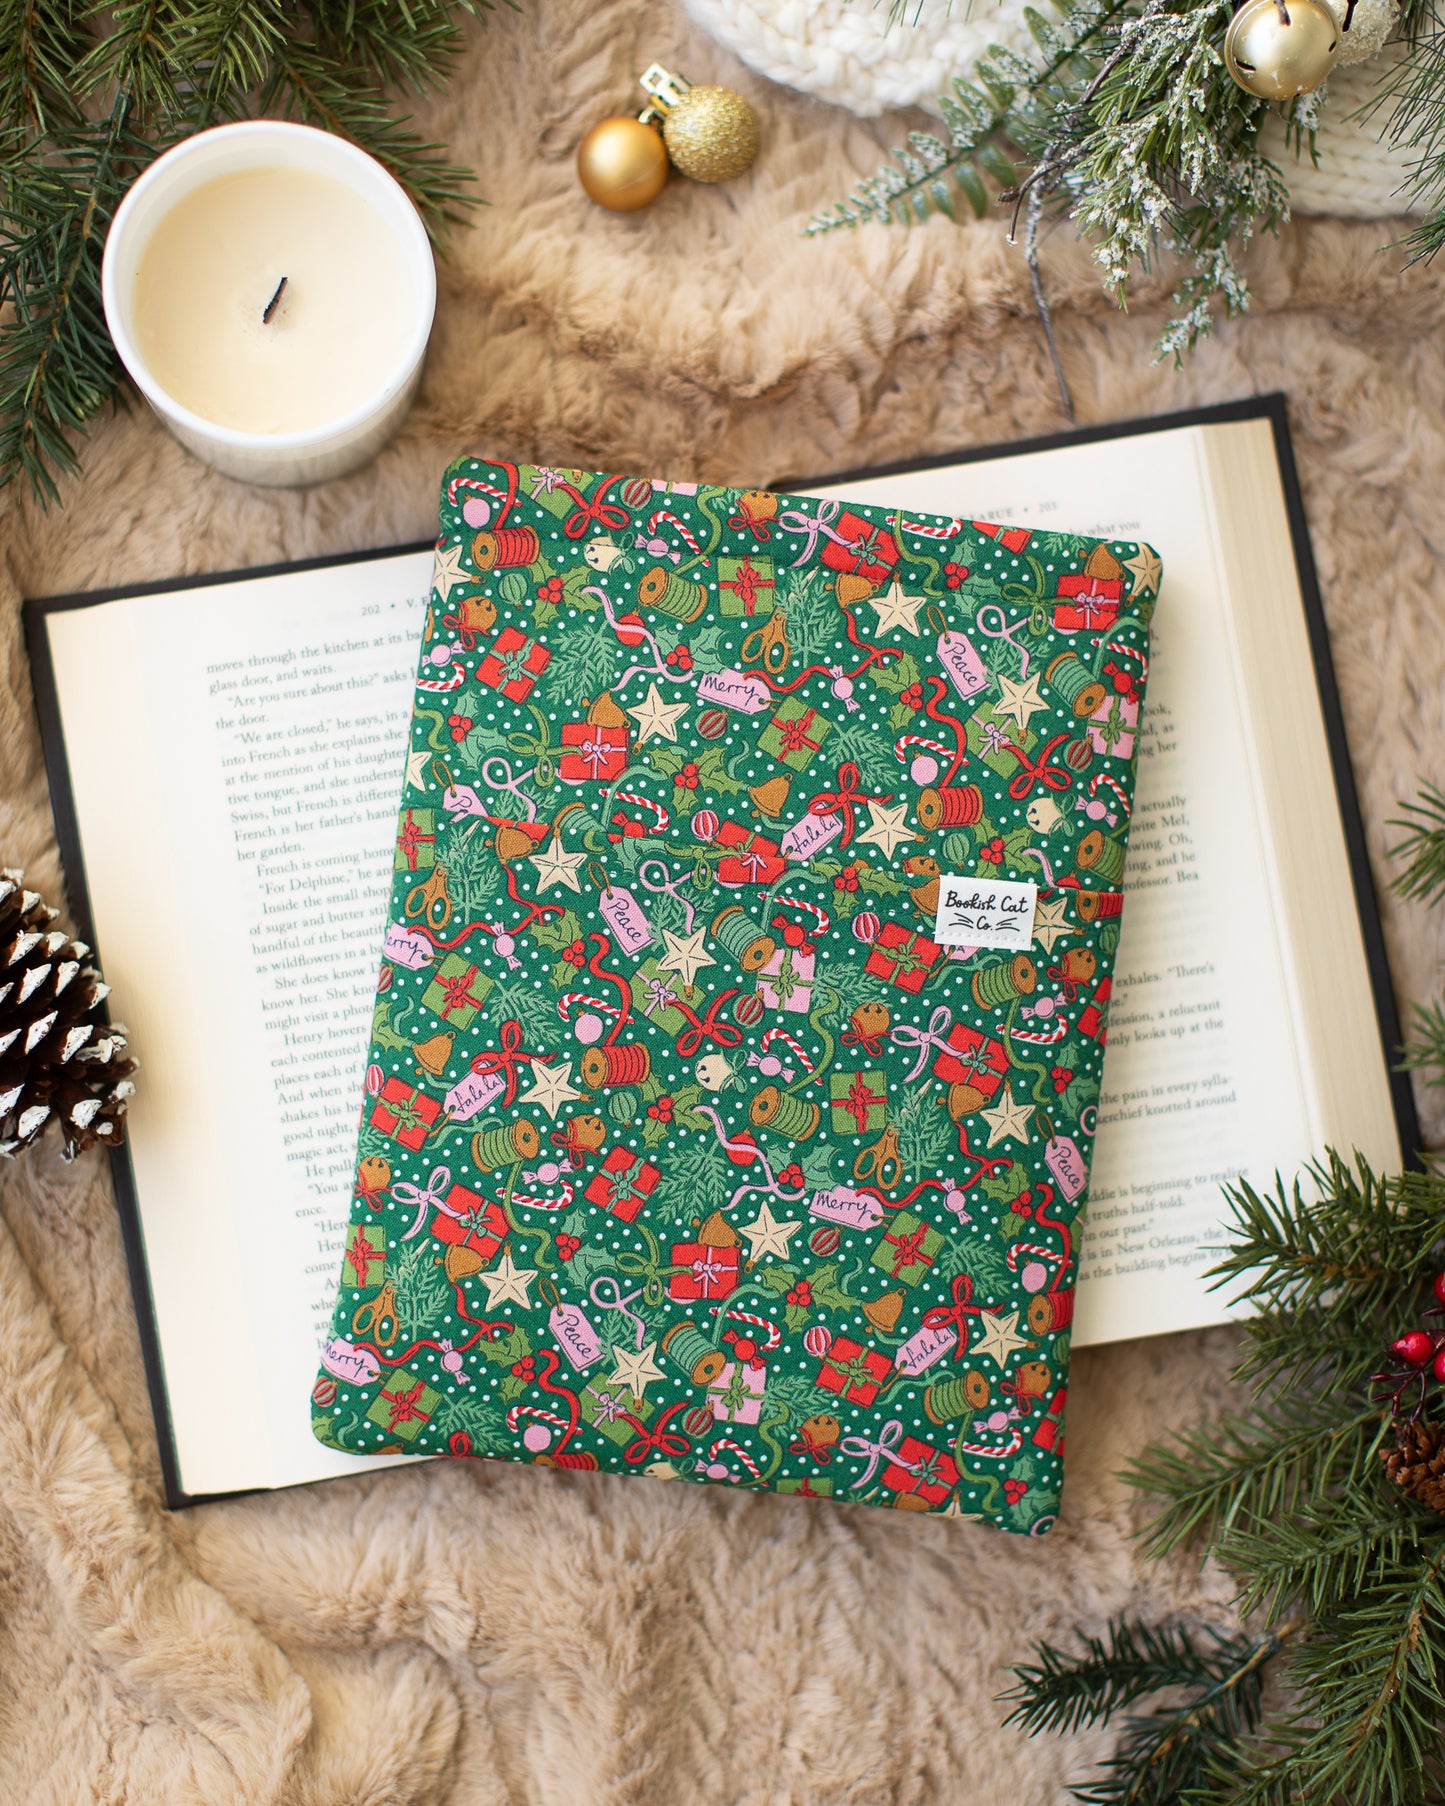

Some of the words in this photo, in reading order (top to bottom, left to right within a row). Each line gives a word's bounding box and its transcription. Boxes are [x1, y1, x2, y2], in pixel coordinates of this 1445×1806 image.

[360, 603, 381, 616] 202
[206, 660, 245, 674] moves
[247, 648, 297, 667] through
[300, 645, 320, 659] the
[323, 639, 369, 655] kitchen
[387, 633, 403, 644] its
[945, 642, 978, 687] Peace
[209, 679, 239, 696] glass
[275, 666, 299, 683] and
[258, 693, 281, 708] you
[282, 688, 308, 700] sure
[309, 681, 344, 696] about
[382, 669, 408, 684] asks
[704, 676, 760, 707] Merry
[215, 717, 235, 730] the
[221, 756, 246, 768] into
[248, 745, 291, 763] French
[308, 740, 329, 753] she
[331, 733, 382, 752] explains
[383, 728, 404, 741] she
[265, 731, 284, 742] are
[239, 770, 259, 784] the
[263, 764, 314, 780] mention
[332, 756, 352, 769] his
[354, 748, 407, 765] daughter
[227, 793, 250, 805] tive
[303, 777, 326, 793] and
[329, 775, 350, 789] she
[271, 804, 292, 817] but
[296, 795, 339, 814] French
[233, 825, 277, 843] French
[294, 820, 314, 833] her
[318, 811, 363, 829] father's
[236, 849, 256, 862] her
[256, 859, 299, 878] French
[314, 853, 361, 868] coming
[362, 847, 395, 861] home
[262, 898, 299, 915] Inside
[303, 895, 323, 909] the
[326, 887, 359, 905] small
[362, 880, 392, 900] shop
[945, 890, 996, 911] Bookish
[1001, 896, 1029, 913] Cat
[265, 920, 298, 935] sugar
[301, 912, 326, 928] and
[327, 910, 365, 924] butter
[607, 898, 642, 943] Peace
[976, 915, 993, 931] Co.
[251, 935, 300, 956] handful
[318, 931, 338, 945] the
[270, 952, 341, 971] wildflowers
[274, 976, 297, 990] She
[301, 972, 329, 986] does
[332, 967, 366, 981] know
[261, 999, 295, 1012] know
[325, 987, 349, 1001] She
[264, 1014, 301, 1031] might
[303, 1011, 329, 1023] visit
[283, 1032, 323, 1047] Henry
[327, 1025, 367, 1040] hovers
[270, 1052, 299, 1068] each
[301, 1041, 362, 1063] contented
[273, 1073, 311, 1091] places
[313, 1064, 342, 1080] each
[277, 1089, 305, 1105] And
[308, 1086, 342, 1100] when
[279, 1108, 320, 1124] shakes
[323, 1104, 343, 1117] his
[283, 1126, 314, 1147] good
[286, 1148, 323, 1163] magic
[1052, 1145, 1081, 1190] Peace
[817, 1193, 872, 1223] Merry
[557, 1314, 592, 1359] Peace
